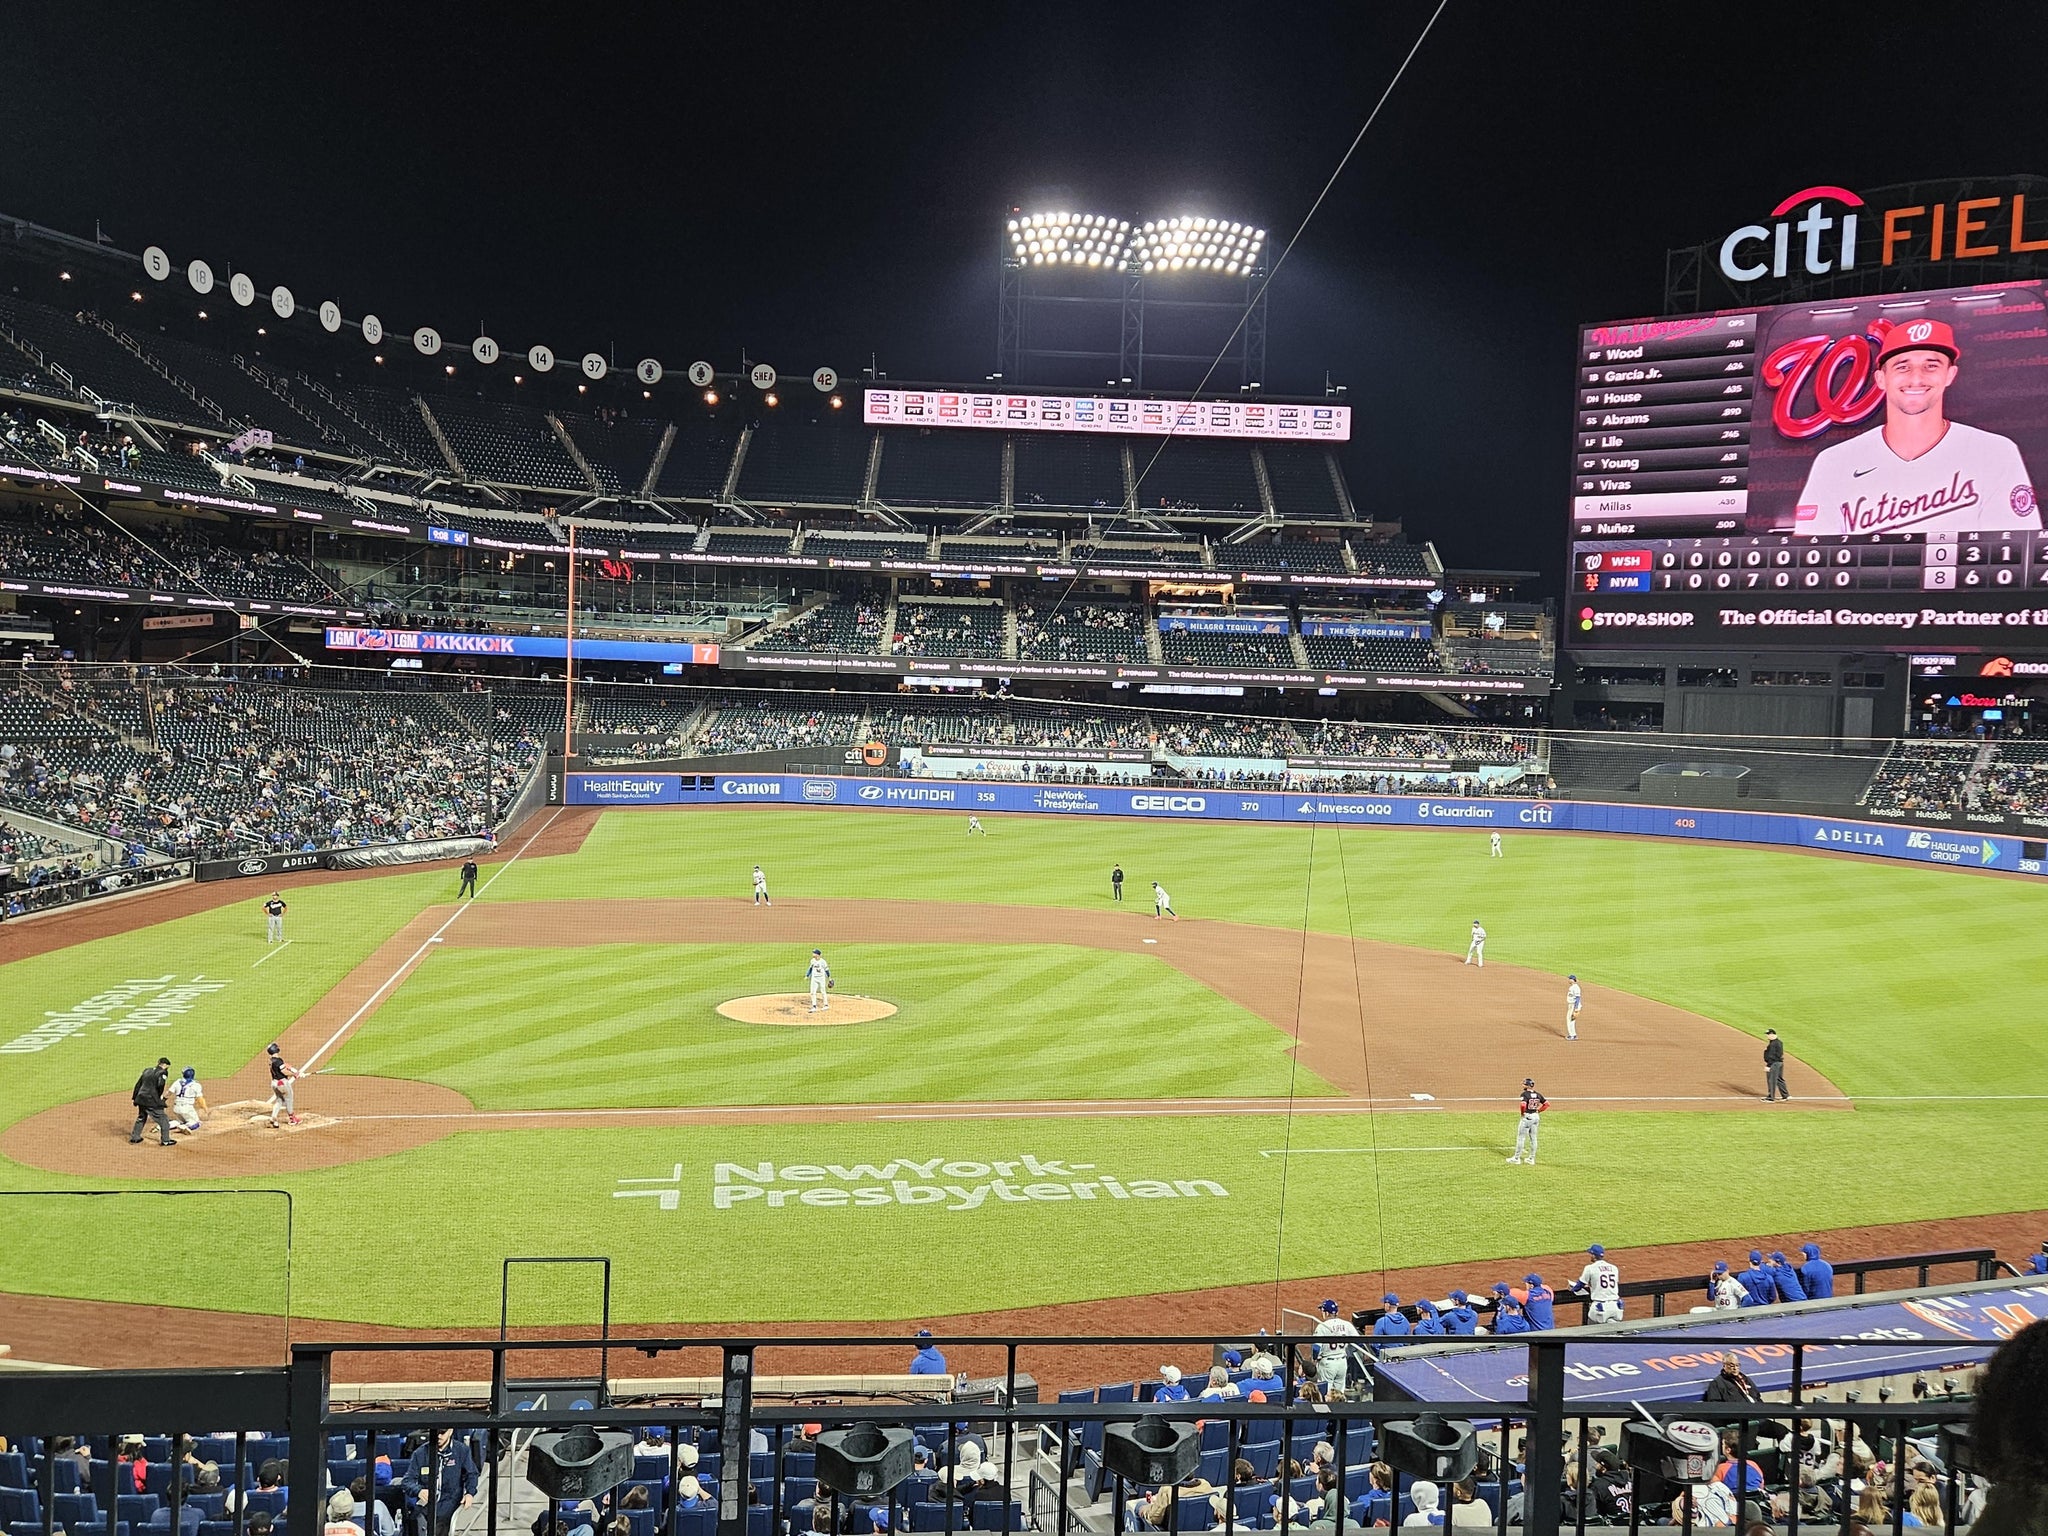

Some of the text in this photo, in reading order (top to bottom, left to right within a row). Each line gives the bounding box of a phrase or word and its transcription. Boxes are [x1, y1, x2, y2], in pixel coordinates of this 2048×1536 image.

[1720, 202, 1857, 281] citi
[152, 256, 160, 272] 5
[194, 270, 207, 284] 18
[237, 282, 248, 298] 16
[278, 294, 288, 309] 24
[326, 310, 335, 324] 17
[367, 323, 378, 336] 36
[422, 334, 434, 348] 31
[480, 345, 492, 356] 41
[1589, 346, 1643, 360] RF Wood
[536, 354, 546, 364] 14
[588, 361, 600, 372] 37
[754, 372, 774, 381] SHEA
[818, 374, 832, 386] 42
[1646, 368, 1662, 380] Jr.
[1586, 396, 1599, 404] DH
[1604, 392, 1642, 404] House
[1586, 417, 1598, 426] SS
[1602, 413, 1650, 426] Abrams
[1586, 436, 1624, 448] LF Lile
[1584, 458, 1640, 470] CF Young
[1600, 480, 1632, 490] Vivas
[1600, 502, 1632, 511] Millas
[1841, 471, 1979, 534] Nationals
[1581, 520, 1736, 534] 2B Nuñez .500
[433, 530, 448, 540] 9:08
[1722, 538, 1730, 546] 3
[1810, 536, 1818, 544] 6
[1904, 534, 1912, 542] 9
[2002, 532, 2010, 540] E
[1612, 546, 2010, 567] WSH 0 0 0 0 0 0 0 0 3 1
[1610, 570, 2012, 588] NYM 1 0 0 7 0 0 0 8 6 0
[1720, 610, 1756, 625] The
[1758, 608, 1832, 626] Official
[1836, 610, 1918, 629] Grocery
[1920, 610, 2002, 626] Partner
[2005, 610, 2030, 625] of
[1226, 624, 1258, 632] TEQUILA
[330, 631, 354, 646] LGM
[394, 634, 418, 648] LGM
[700, 648, 712, 661] 7
[1960, 694, 1996, 706] Coors
[872, 750, 884, 758] 13
[584, 780, 662, 794] HealthEquity
[722, 781, 780, 794] Canon
[888, 789, 954, 801] HYUNDAI
[977, 793, 995, 801] 358
[1044, 790, 1086, 800] NewYork-
[1044, 800, 1098, 811] Presbyterian
[1131, 796, 1205, 812] GEICO
[1241, 802, 1259, 812] 370
[1318, 802, 1392, 815] Invesco QQQ
[1433, 806, 1494, 818] Guardian
[1520, 807, 1552, 823] citi
[1870, 808, 1904, 818] HubSpot
[1916, 810, 1952, 820] HubSpot
[1675, 819, 1696, 828] 408
[1967, 814, 2004, 824] HubSpot
[1831, 830, 1884, 846] DELTA
[1931, 842, 1979, 854] HAUGLAND
[291, 856, 318, 866] DELTA
[1930, 852, 1960, 862] GROUP
[243, 861, 262, 872] Ford
[2018, 860, 2040, 872] 380
[715, 1155, 1095, 1184] NewYork-
[714, 1176, 1229, 1210] Presbyterian
[1600, 1274, 1615, 1288] 65
[1564, 1360, 1638, 1381] the
[1642, 1350, 1723, 1371] new
[1672, 1425, 1711, 1434] Mets
